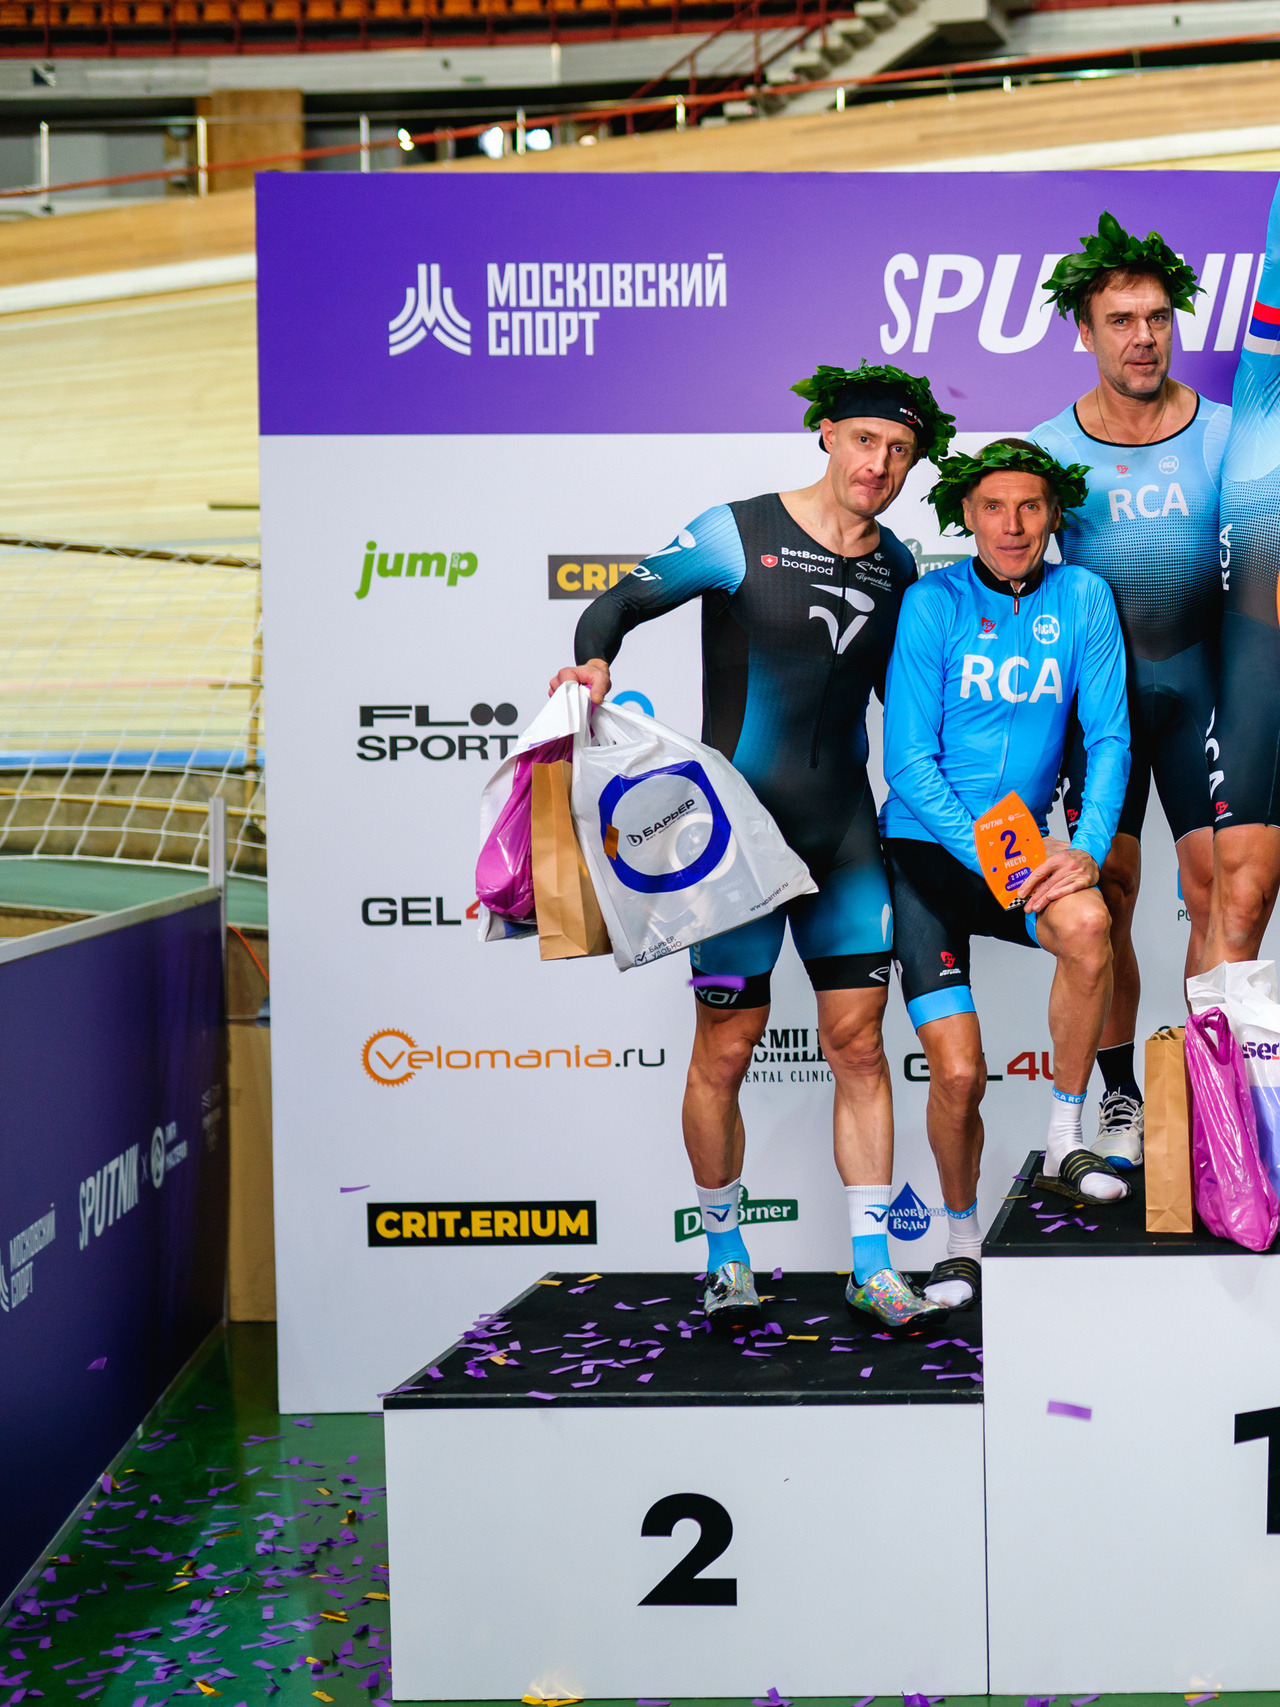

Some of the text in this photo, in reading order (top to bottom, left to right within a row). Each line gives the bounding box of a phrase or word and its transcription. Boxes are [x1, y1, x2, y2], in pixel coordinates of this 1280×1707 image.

[487, 253, 727, 307] МОСКОВСКИЙ
[488, 311, 599, 355] СПОРТ
[1108, 482, 1190, 522] RCA
[354, 540, 479, 600] jump
[781, 546, 835, 564] BetBoom
[1220, 524, 1233, 591] RCA
[959, 653, 1064, 704] RCA
[356, 735, 519, 761] SPORT
[642, 799, 696, 838] БАРЬЕР
[1000, 830, 1022, 860] 2
[1004, 855, 1027, 869] МЕСТО
[744, 1070, 833, 1083] ENTAL CLINIC
[79, 1142, 139, 1251] SPUTNIK
[738, 1203, 793, 1224] örner
[375, 1209, 590, 1239] CRIT.ERIUM
[638, 1493, 738, 1607] 2
